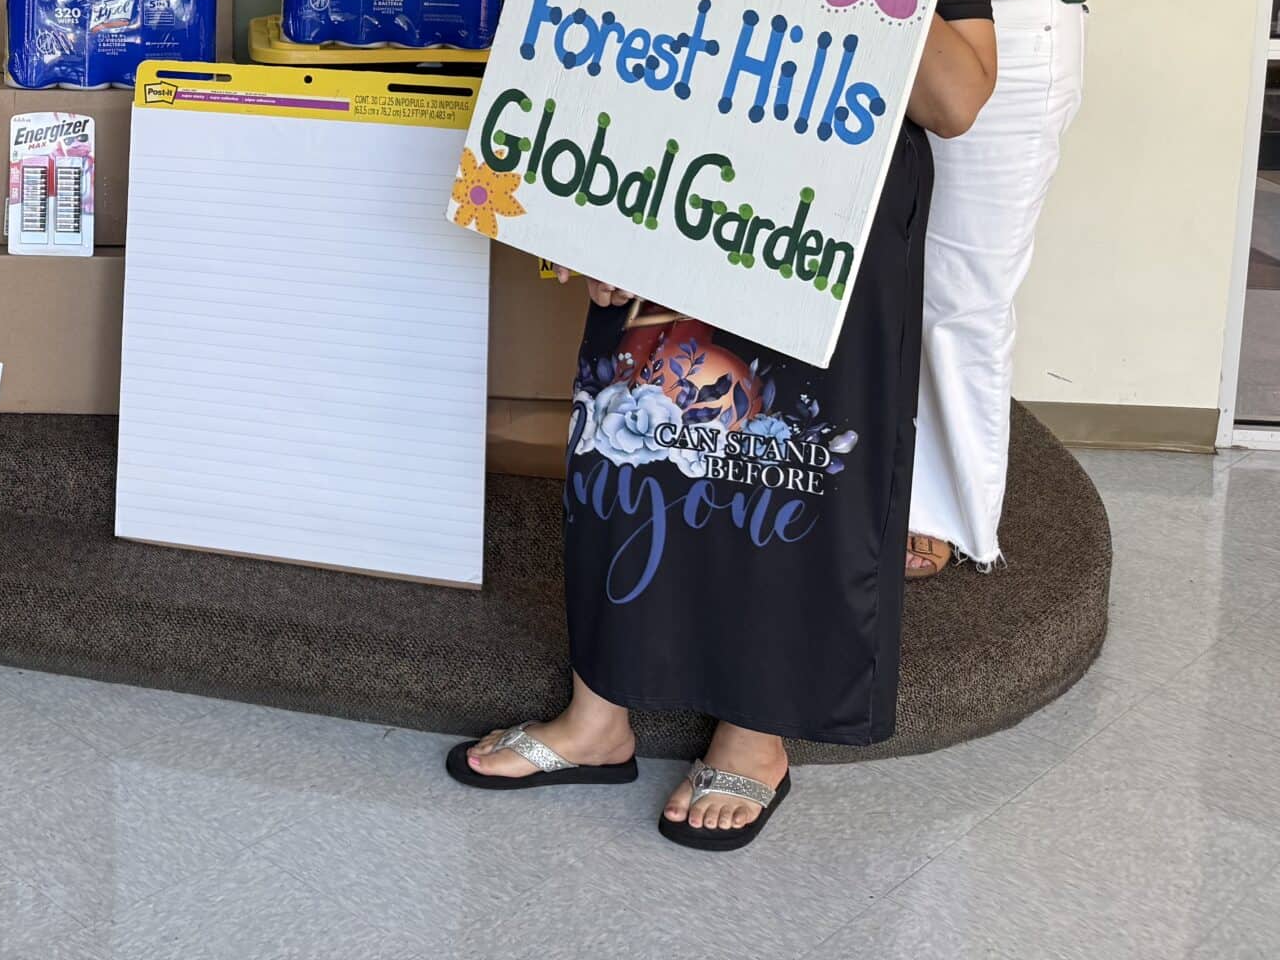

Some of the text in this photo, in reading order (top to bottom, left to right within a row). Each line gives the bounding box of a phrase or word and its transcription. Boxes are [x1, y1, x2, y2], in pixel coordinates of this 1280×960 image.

[54, 7, 81, 18] 320
[147, 88, 173, 97] Post-it
[718, 9, 886, 145] Hills
[14, 118, 90, 146] Energizer
[28, 141, 48, 151] MAX
[481, 89, 854, 300] Global Garden
[653, 422, 831, 468] CAN STAND
[704, 456, 825, 496] BEFORE
